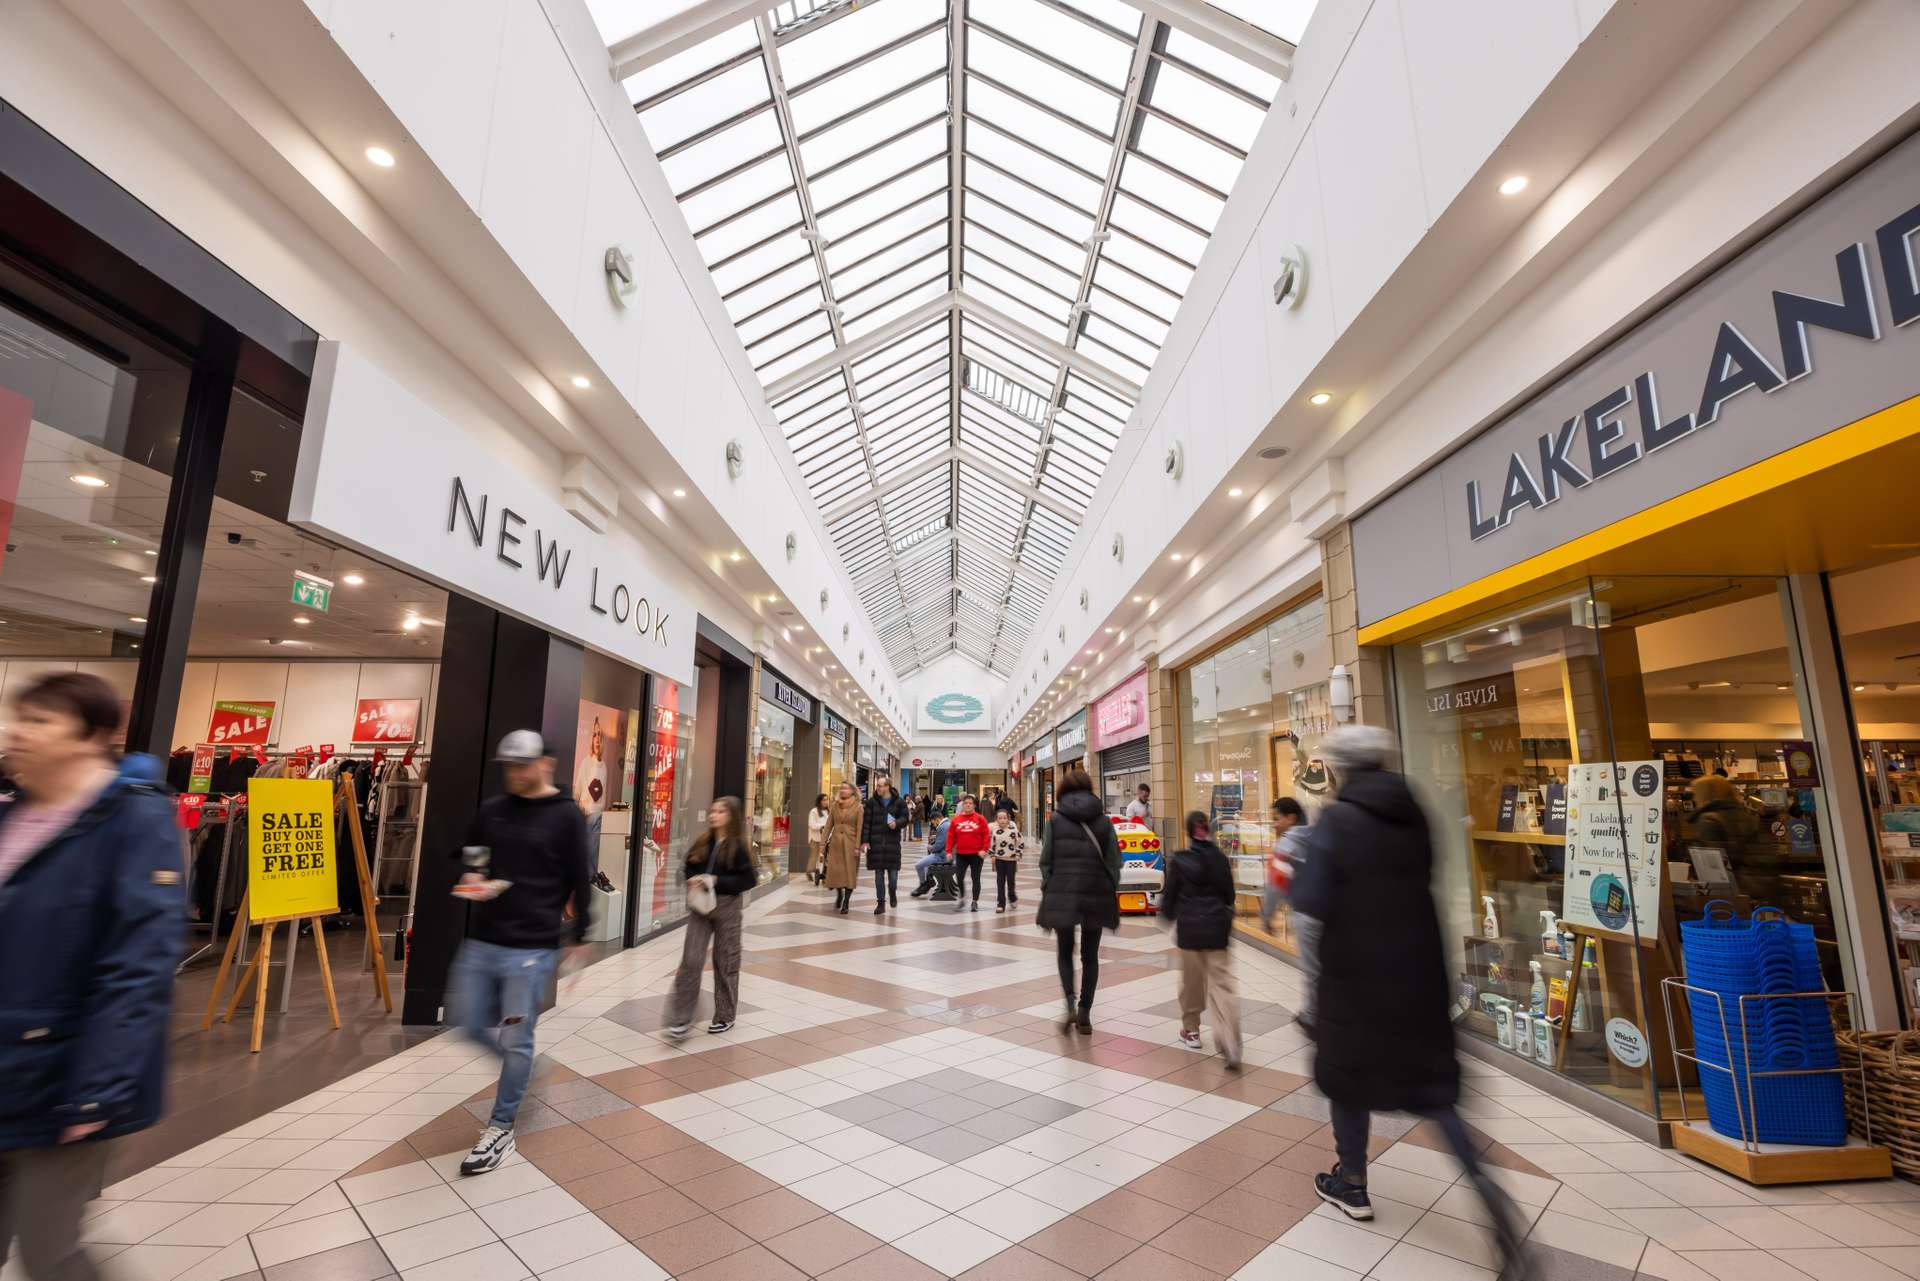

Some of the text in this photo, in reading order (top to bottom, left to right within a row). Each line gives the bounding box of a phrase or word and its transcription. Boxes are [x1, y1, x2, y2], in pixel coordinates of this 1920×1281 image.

[448, 476, 669, 648] NEW LOOK
[213, 716, 267, 742] SALE
[262, 812, 322, 830] SALE
[262, 830, 323, 842] BUY ONE
[262, 841, 323, 854] GET ONE
[1583, 846, 1600, 857] Now
[1602, 846, 1615, 858] for
[263, 852, 324, 873] FREE
[262, 869, 325, 880] LIMITED OFFER
[1614, 1030, 1638, 1045] Which?
